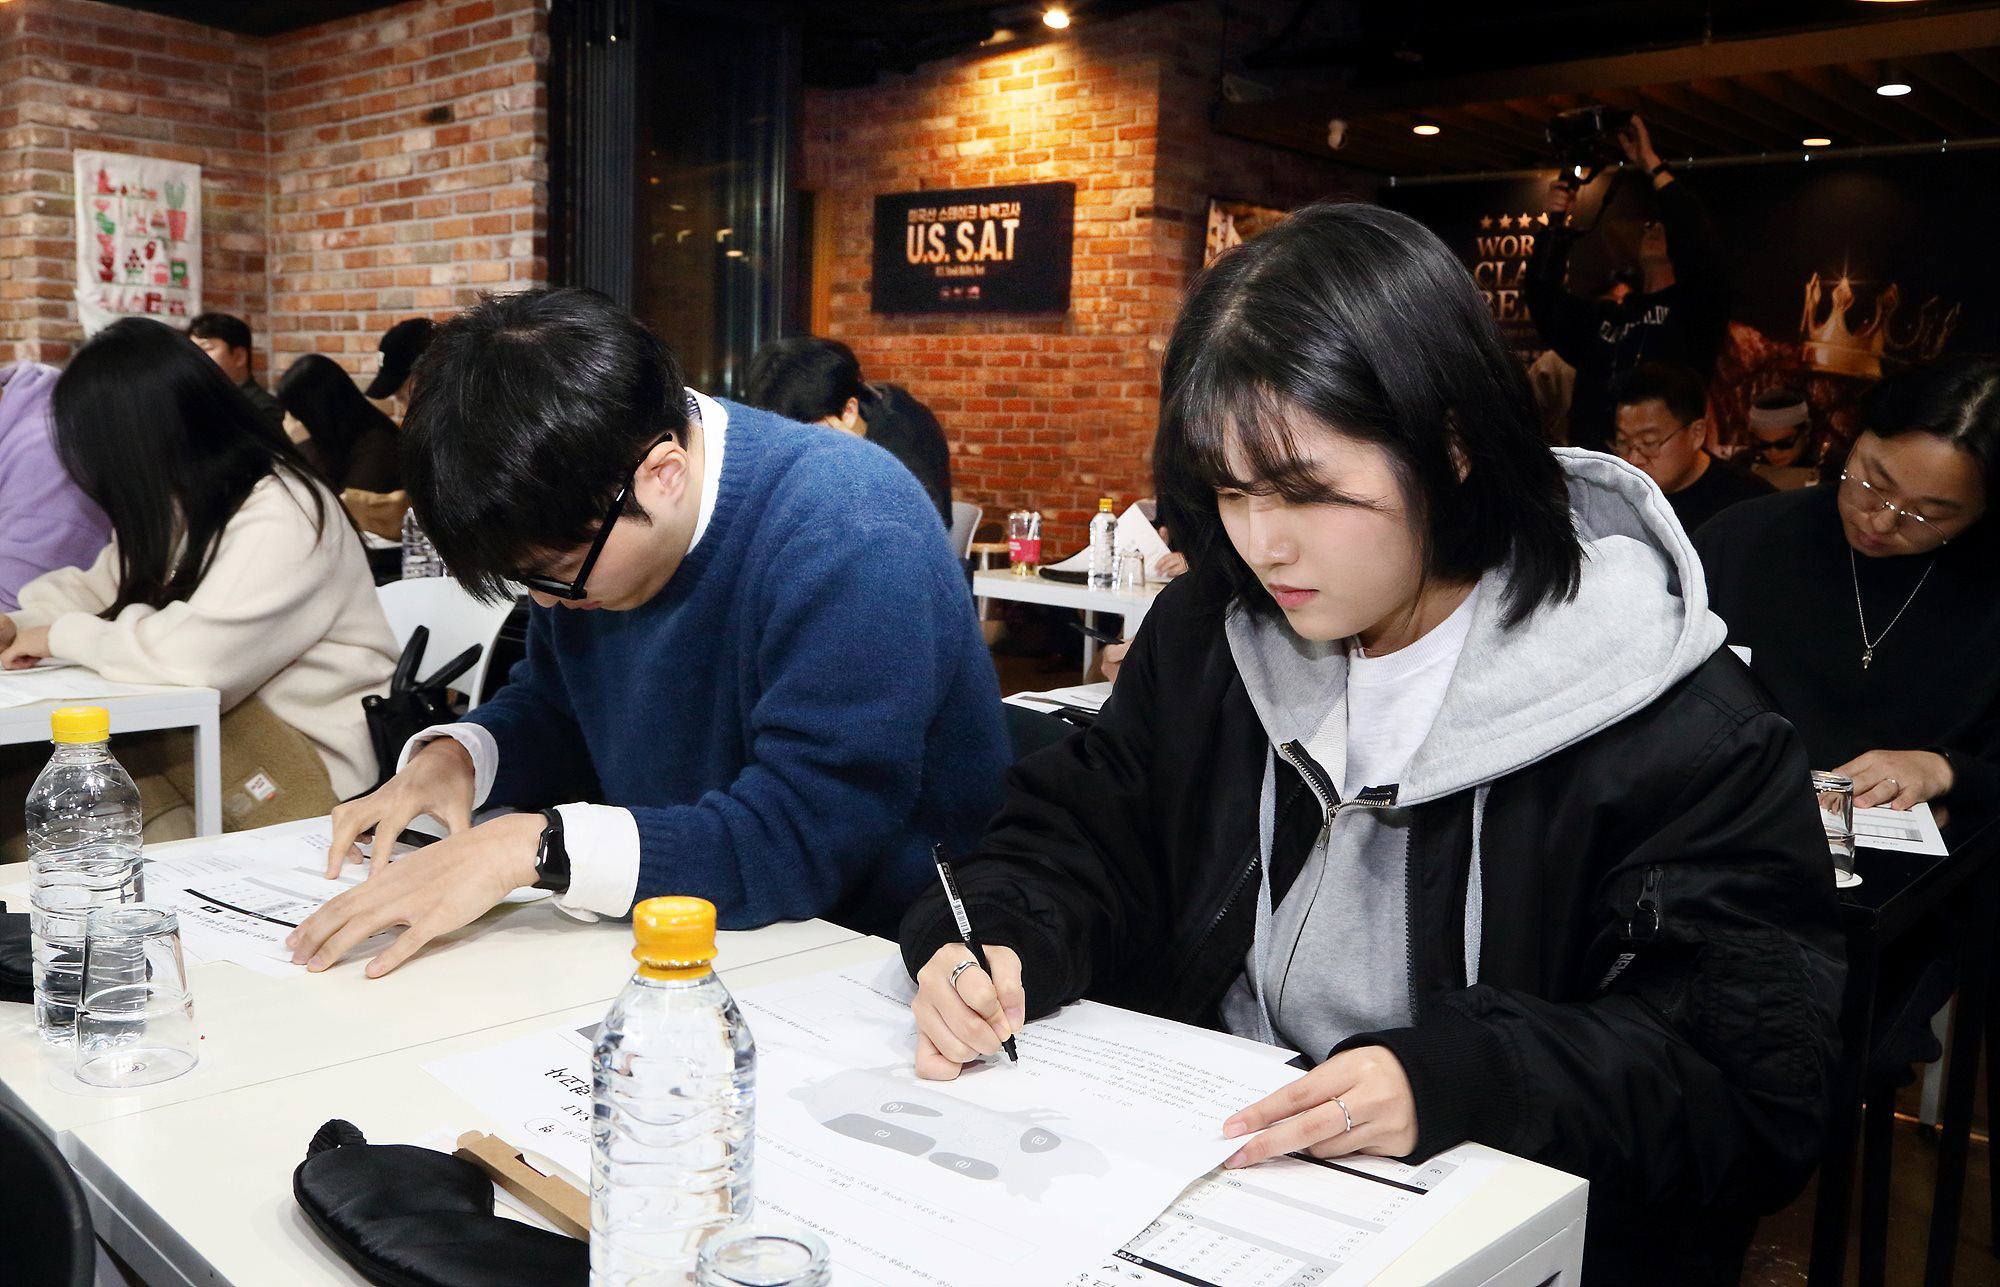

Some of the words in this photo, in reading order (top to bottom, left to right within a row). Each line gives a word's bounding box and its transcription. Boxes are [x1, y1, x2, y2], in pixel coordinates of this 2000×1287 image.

[906, 222, 950, 264] U.S.
[955, 219, 1020, 262] S.A.T
[1476, 235, 1535, 257] WOR
[1474, 260, 1527, 288] CLA
[545, 1067, 591, 1097] 력고사
